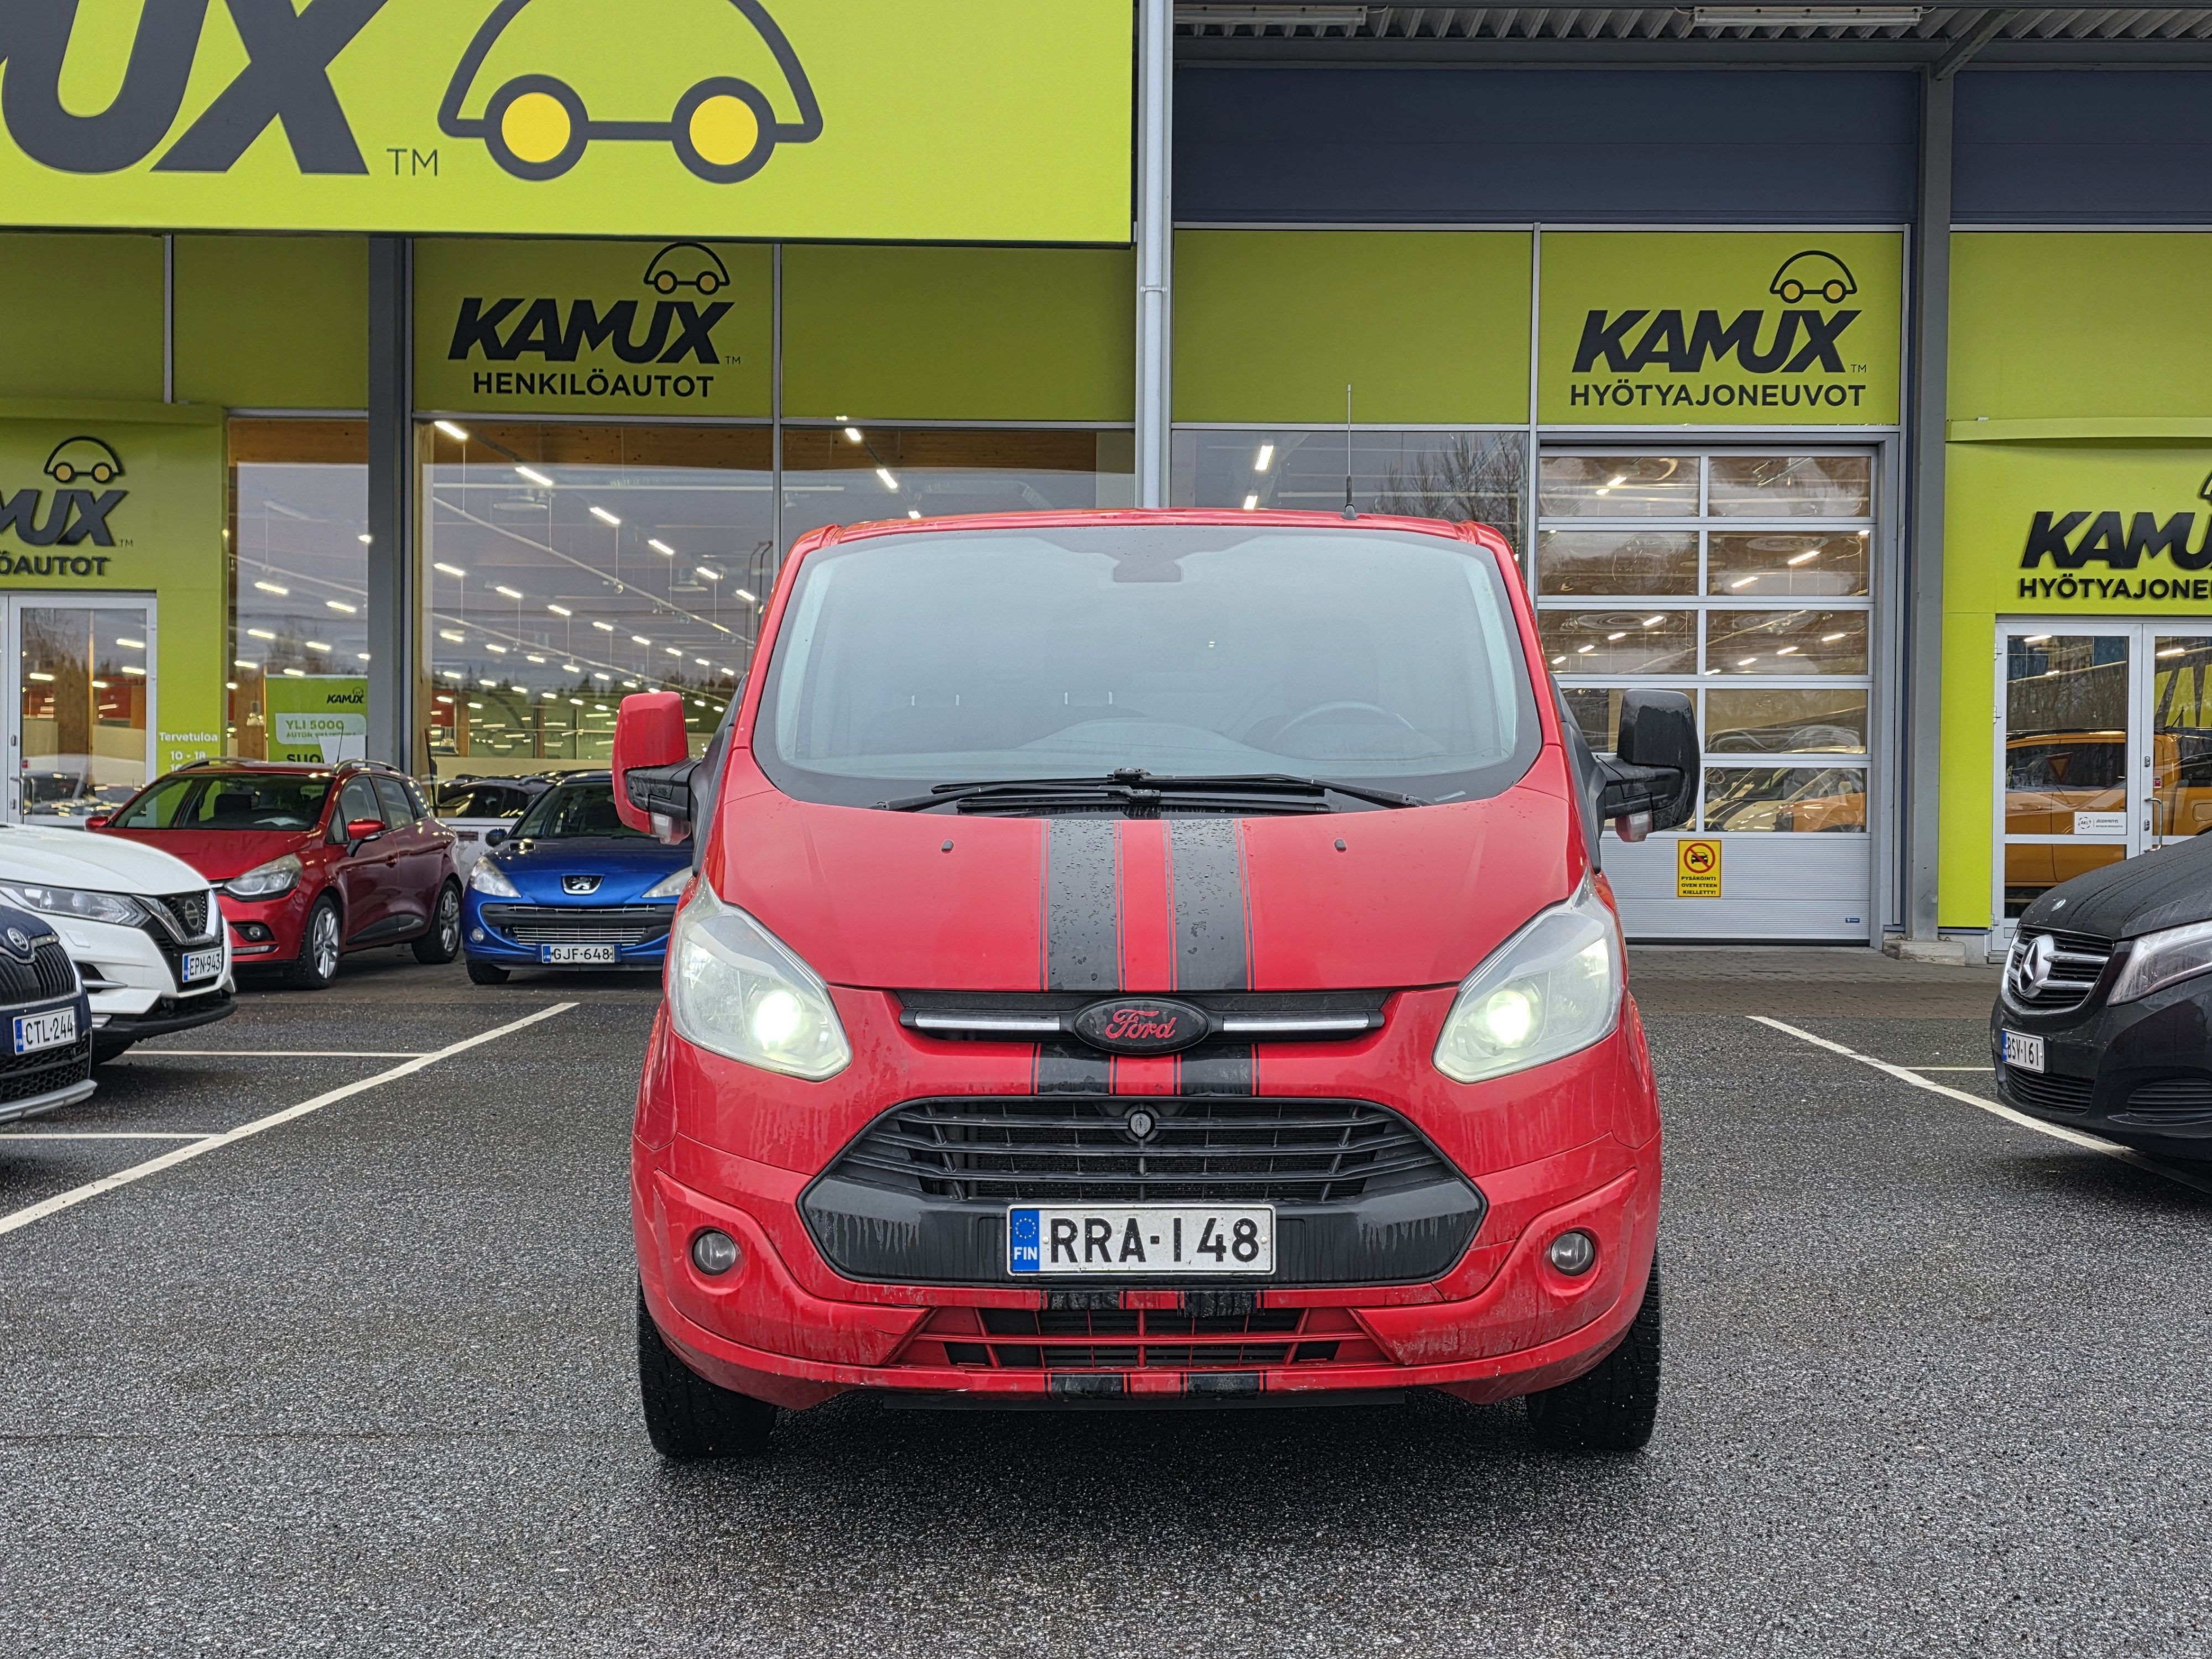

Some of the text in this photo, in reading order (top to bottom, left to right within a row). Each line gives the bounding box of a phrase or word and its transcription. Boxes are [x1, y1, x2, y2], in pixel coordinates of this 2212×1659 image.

[0, 0, 438, 176] UX TM
[448, 298, 735, 364] KAMUX
[1572, 310, 1863, 373] KAMUX
[473, 368, 714, 397] HENKILÖAUTOT
[1570, 379, 1866, 406] HYÖTYAJONEUVOT
[2021, 511, 2212, 570] KAMU
[2019, 573, 2212, 598] HYÖTYAJONE
[327, 694, 364, 704] KAMUX
[159, 732, 218, 742] Tervetuloa
[285, 720, 344, 729] YLI 5000
[171, 751, 183, 760] 10
[286, 754, 325, 763] SUO
[190, 953, 221, 976] EPN-943
[554, 948, 609, 961] GJF-648
[25, 1014, 73, 1045] CTL-244
[1105, 1008, 1177, 1040] Ford
[2007, 1036, 2039, 1066] BSV-161
[1014, 1217, 1259, 1263] FIN RRA-148
